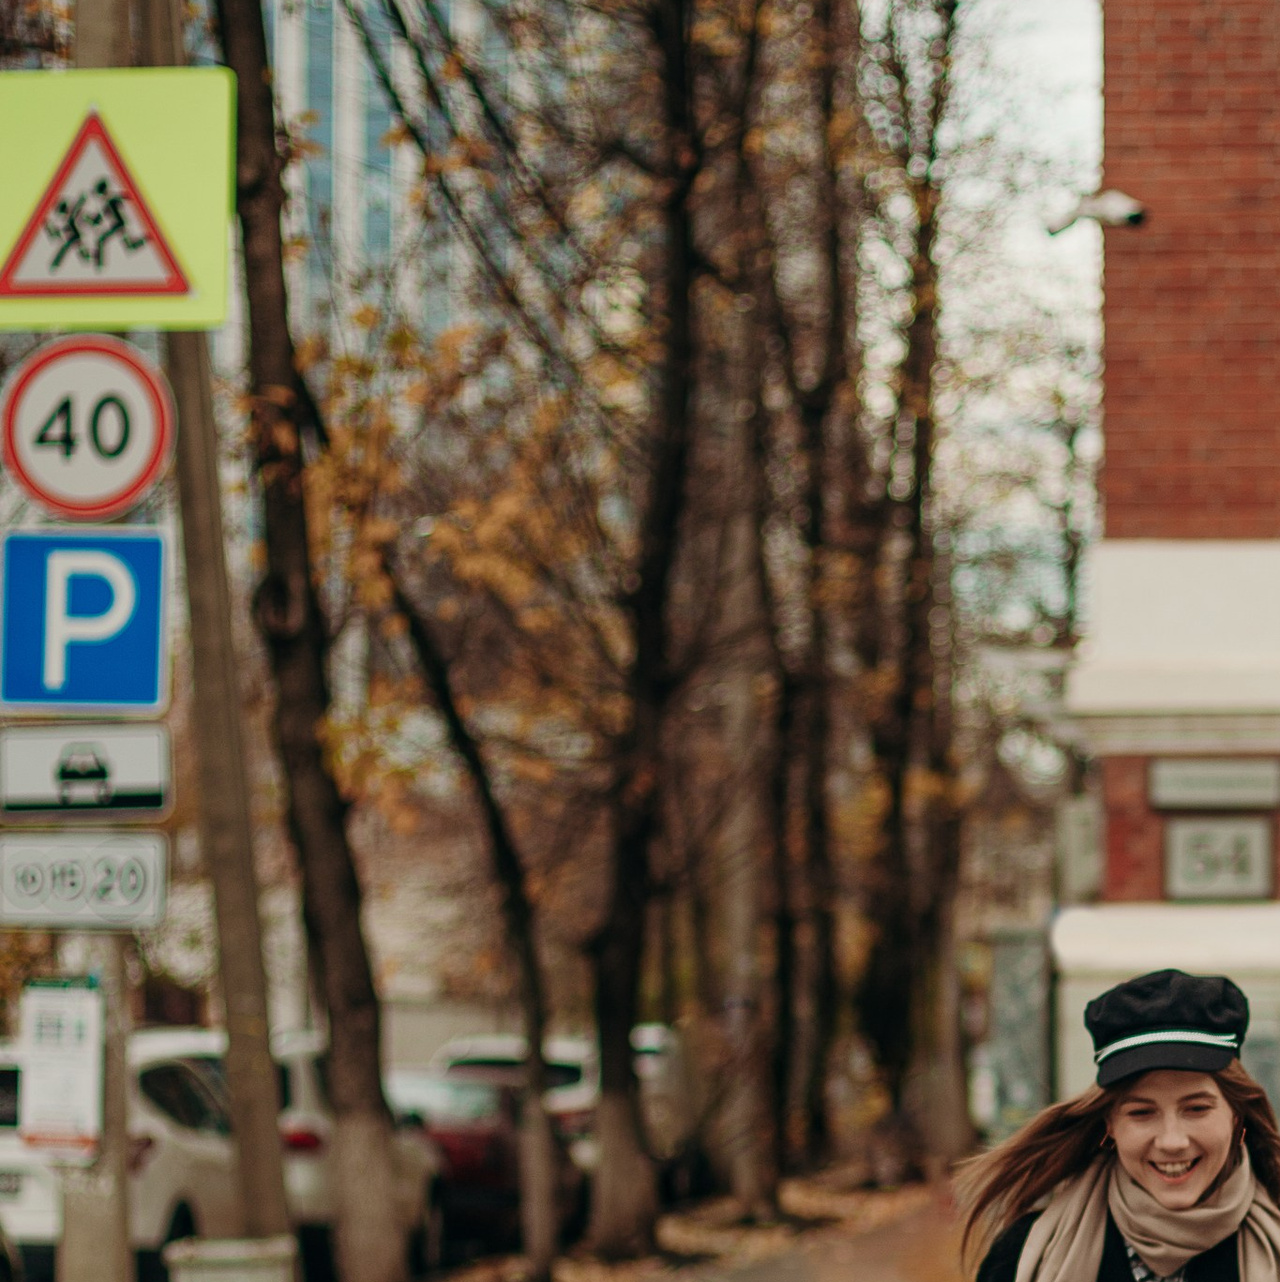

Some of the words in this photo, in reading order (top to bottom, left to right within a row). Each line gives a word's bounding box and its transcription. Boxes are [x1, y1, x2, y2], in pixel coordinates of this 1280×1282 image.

[34, 396, 131, 459] 40
[43, 549, 136, 691] P
[94, 856, 146, 901] 20
